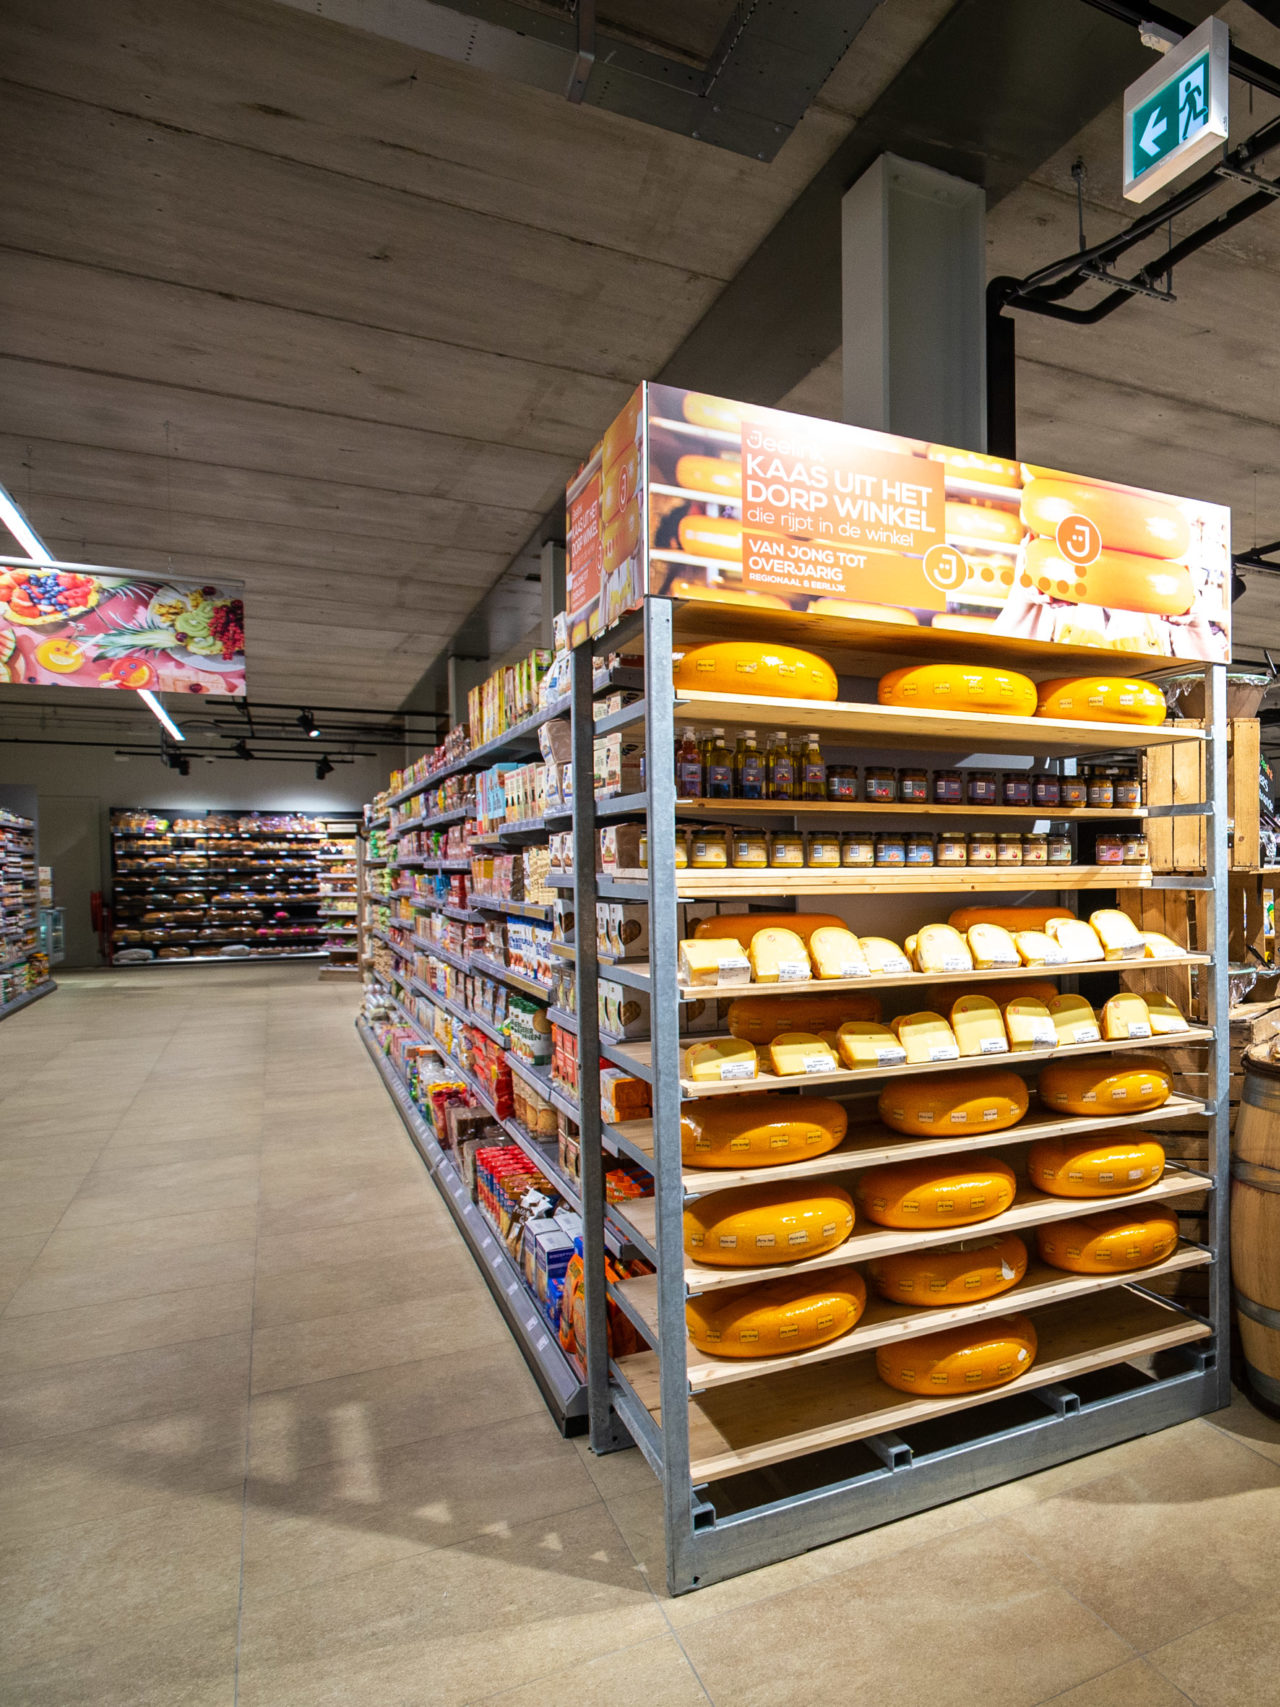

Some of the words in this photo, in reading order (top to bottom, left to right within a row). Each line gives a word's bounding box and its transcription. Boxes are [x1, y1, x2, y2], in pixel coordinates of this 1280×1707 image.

[747, 453, 828, 488] KAAS
[834, 470, 876, 497] UIT
[882, 479, 932, 507] HET
[747, 480, 827, 512] DORP
[834, 494, 935, 533] WINKEL
[747, 507, 775, 524] die
[781, 513, 814, 532] rijpt
[819, 517, 833, 534] in
[839, 522, 860, 538] de
[866, 528, 914, 547] winkel
[749, 539, 784, 556] VAN
[788, 546, 834, 564] JONG
[837, 552, 867, 568] TOT
[749, 556, 843, 581] OVERJARIG
[749, 573, 801, 587] REGIONAAL
[811, 580, 846, 592] EERLIJK
